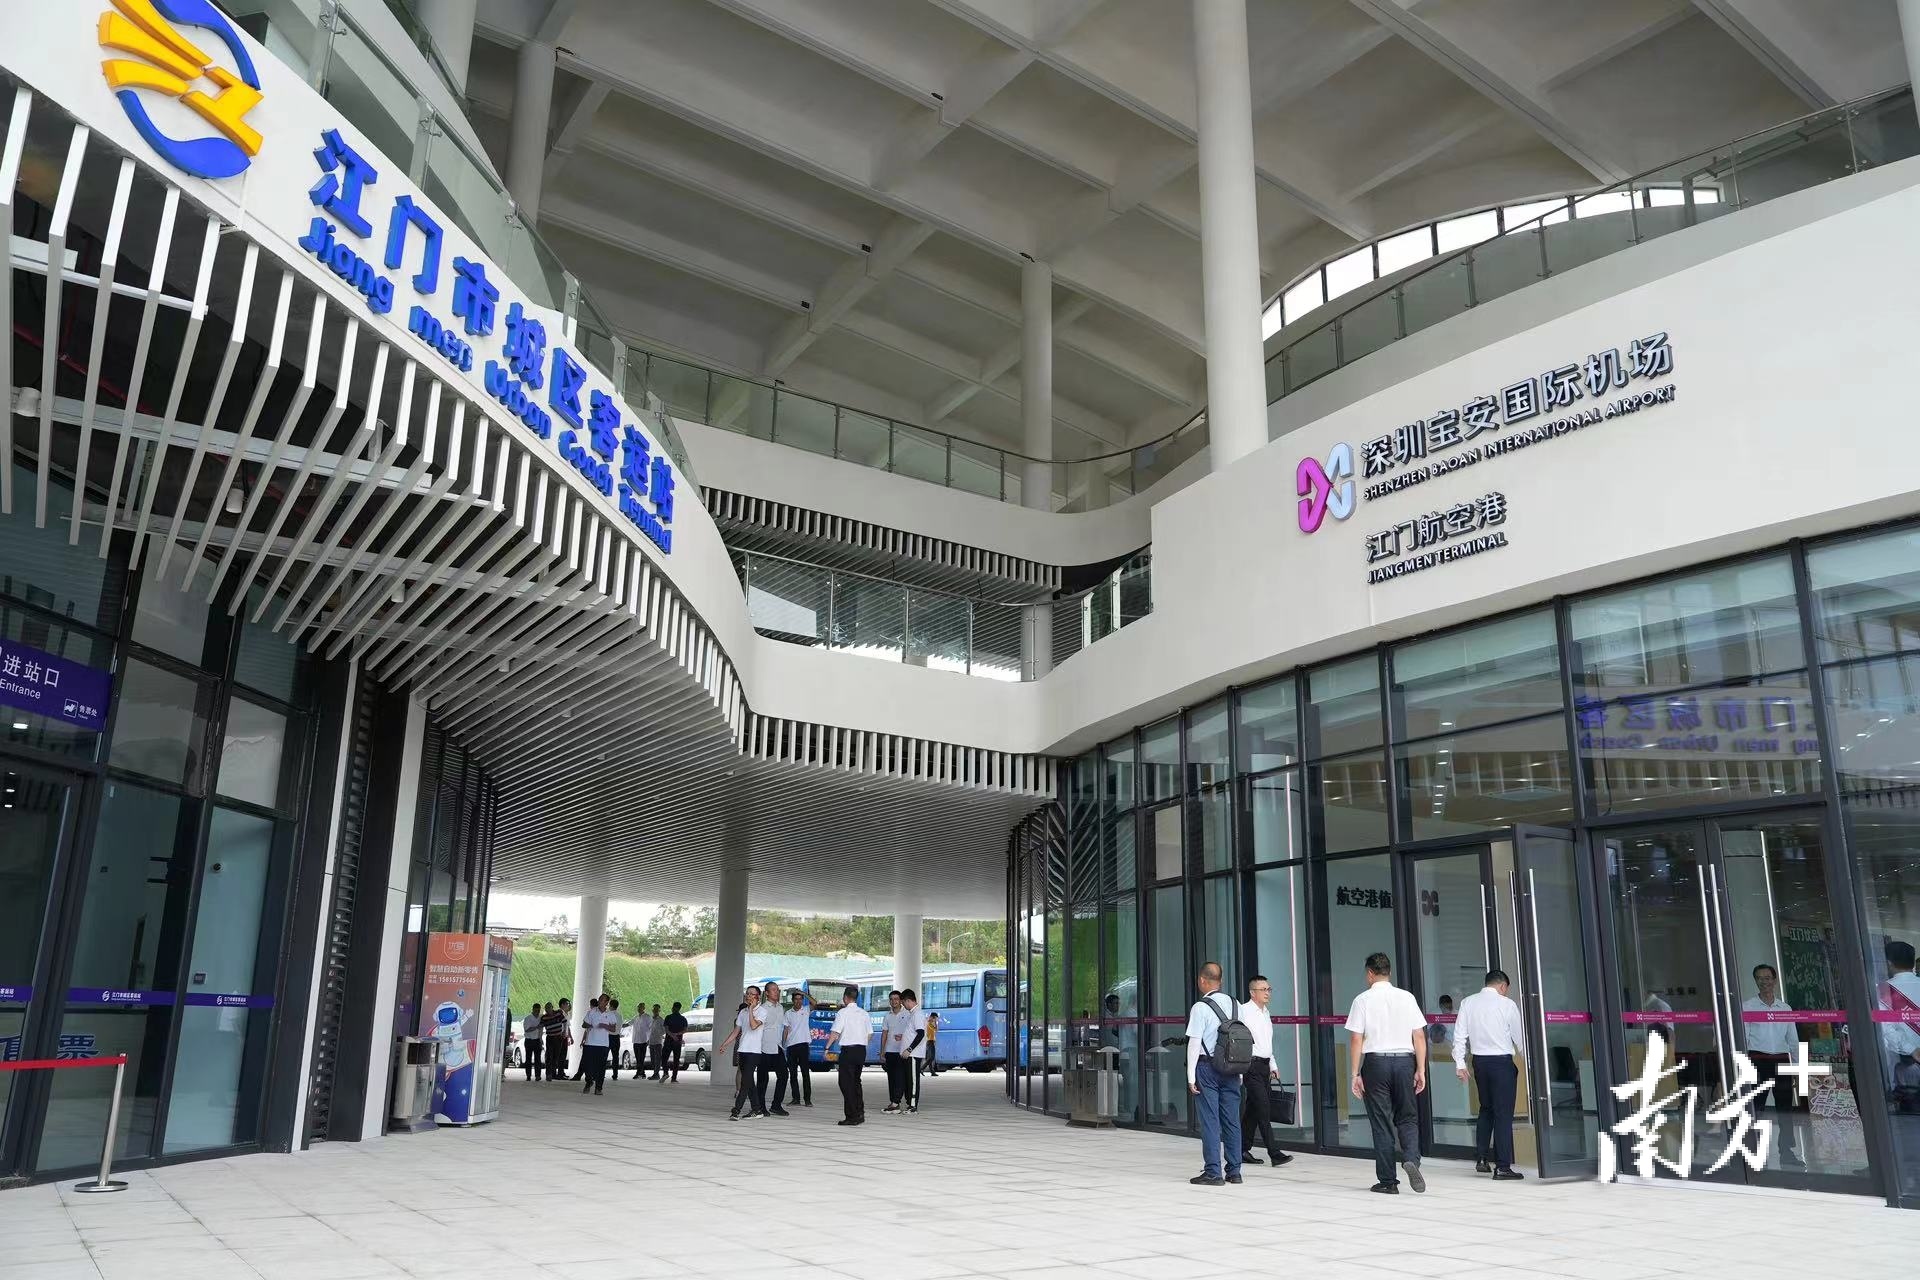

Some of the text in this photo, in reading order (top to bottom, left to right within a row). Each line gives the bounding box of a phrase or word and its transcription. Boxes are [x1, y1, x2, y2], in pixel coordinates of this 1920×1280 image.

[298, 217, 394, 314] Jiang
[408, 305, 472, 372] men
[484, 360, 551, 440] Urban
[558, 430, 613, 497] Coach
[309, 128, 674, 524] 江门市城区客运站
[1361, 331, 1675, 478] 深圳宝安国际机场
[1363, 383, 1677, 501] SHENZHEN BAOAN INTERNATIONAL AIRPORT
[1365, 492, 1507, 563] 江门航空港
[1367, 531, 1509, 584] JIANGMEN TERMINAL
[0, 678, 41, 699] Entrance
[2, 654, 60, 688] 进站口
